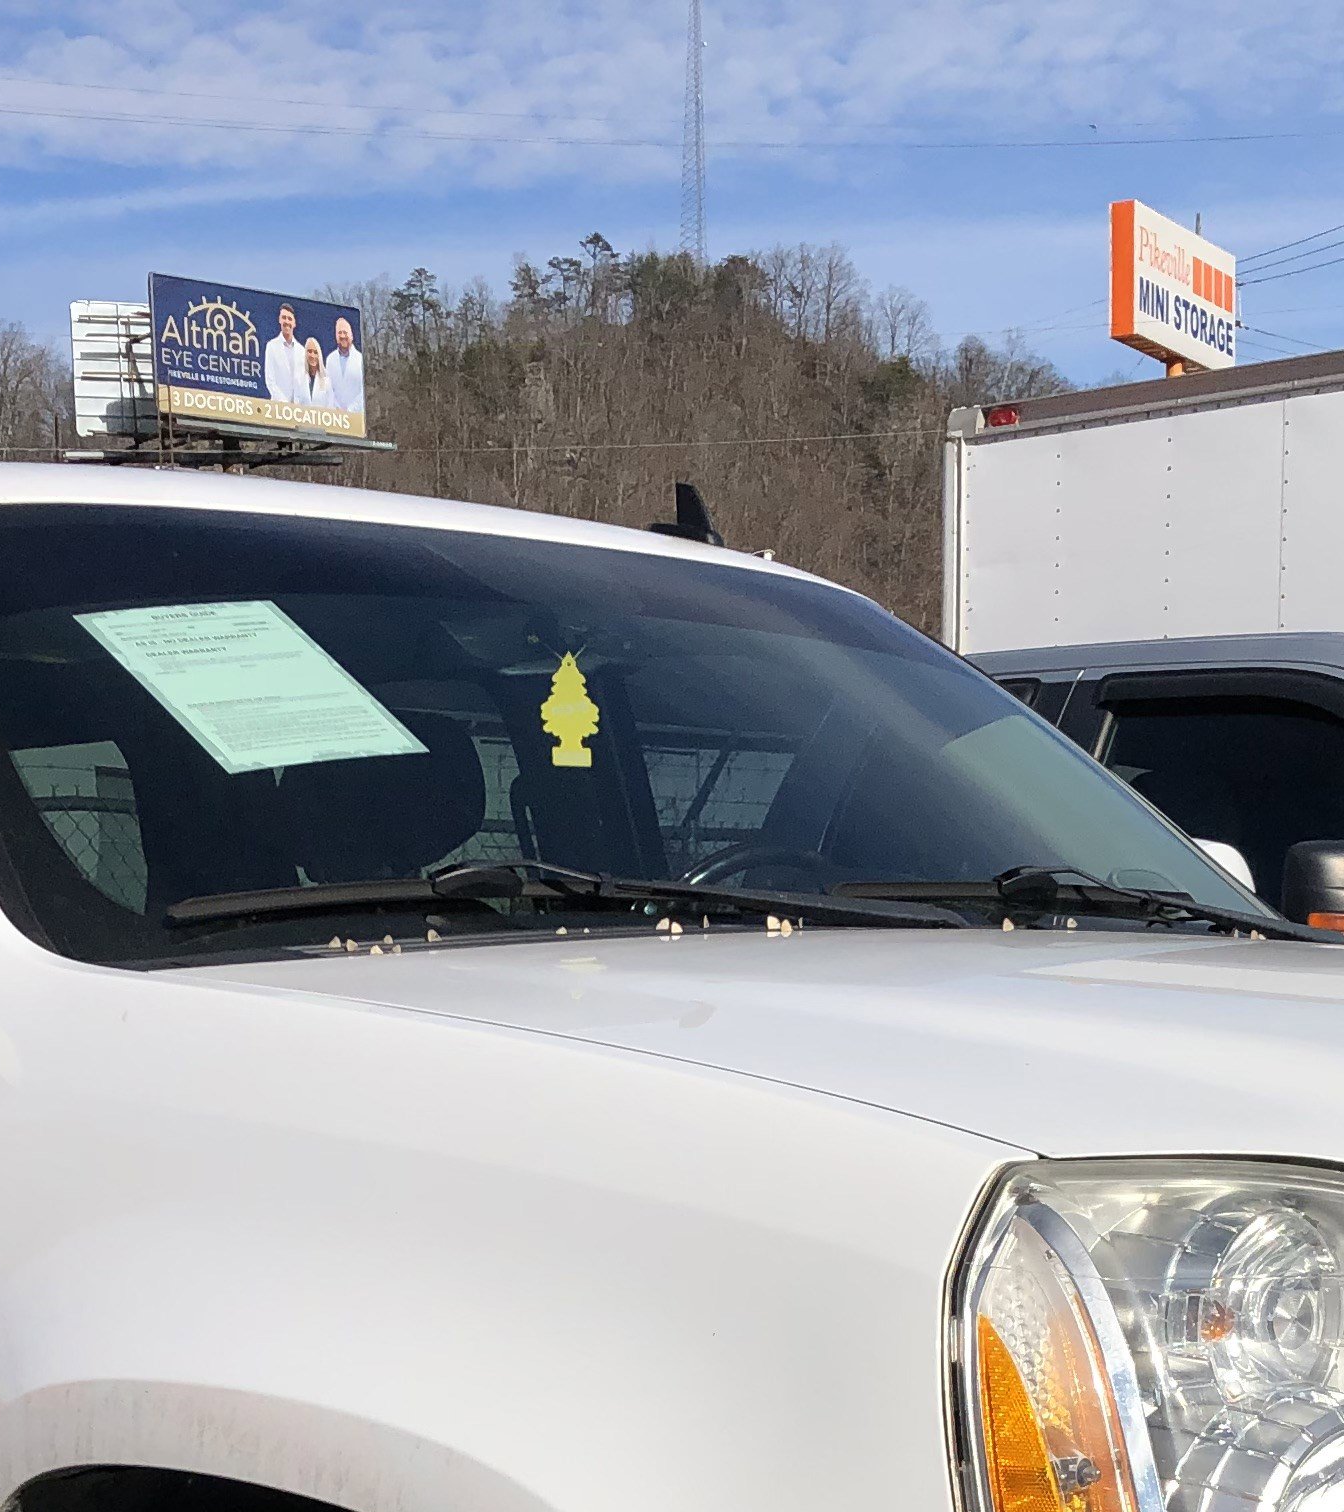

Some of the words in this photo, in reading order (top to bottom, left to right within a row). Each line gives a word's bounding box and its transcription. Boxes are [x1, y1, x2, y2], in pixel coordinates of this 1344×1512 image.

[1139, 226, 1191, 286] Pikeville
[161, 315, 260, 357] Altman
[1139, 276, 1169, 325] MINI
[1174, 294, 1234, 357] STORAGE
[161, 347, 193, 368] EYE
[197, 353, 262, 378] CENTER
[172, 391, 181, 407] 3
[183, 391, 253, 416] DOCTORS
[264, 403, 273, 418] 2
[275, 406, 351, 430] LOCATIONS
